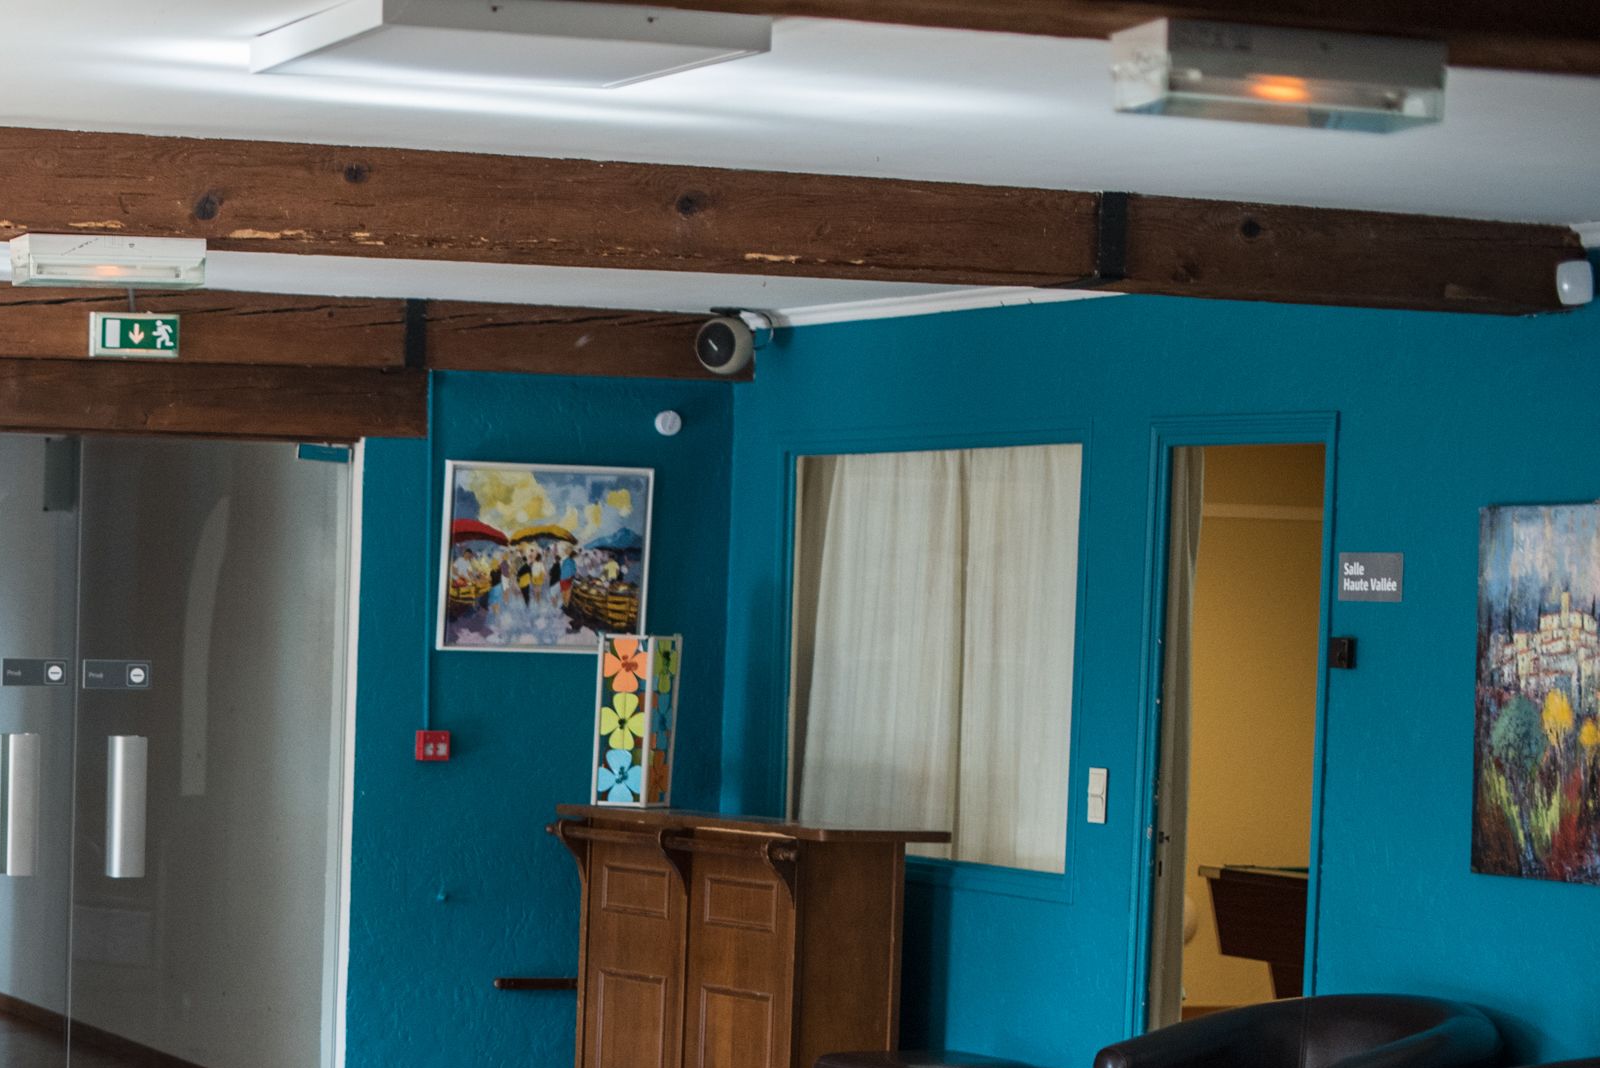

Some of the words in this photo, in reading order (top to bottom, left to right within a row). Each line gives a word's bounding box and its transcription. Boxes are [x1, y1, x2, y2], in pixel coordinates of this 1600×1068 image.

[1343, 561, 1365, 576] Salle
[1343, 577, 1369, 591] Haute
[1370, 577, 1398, 591] Vallée
